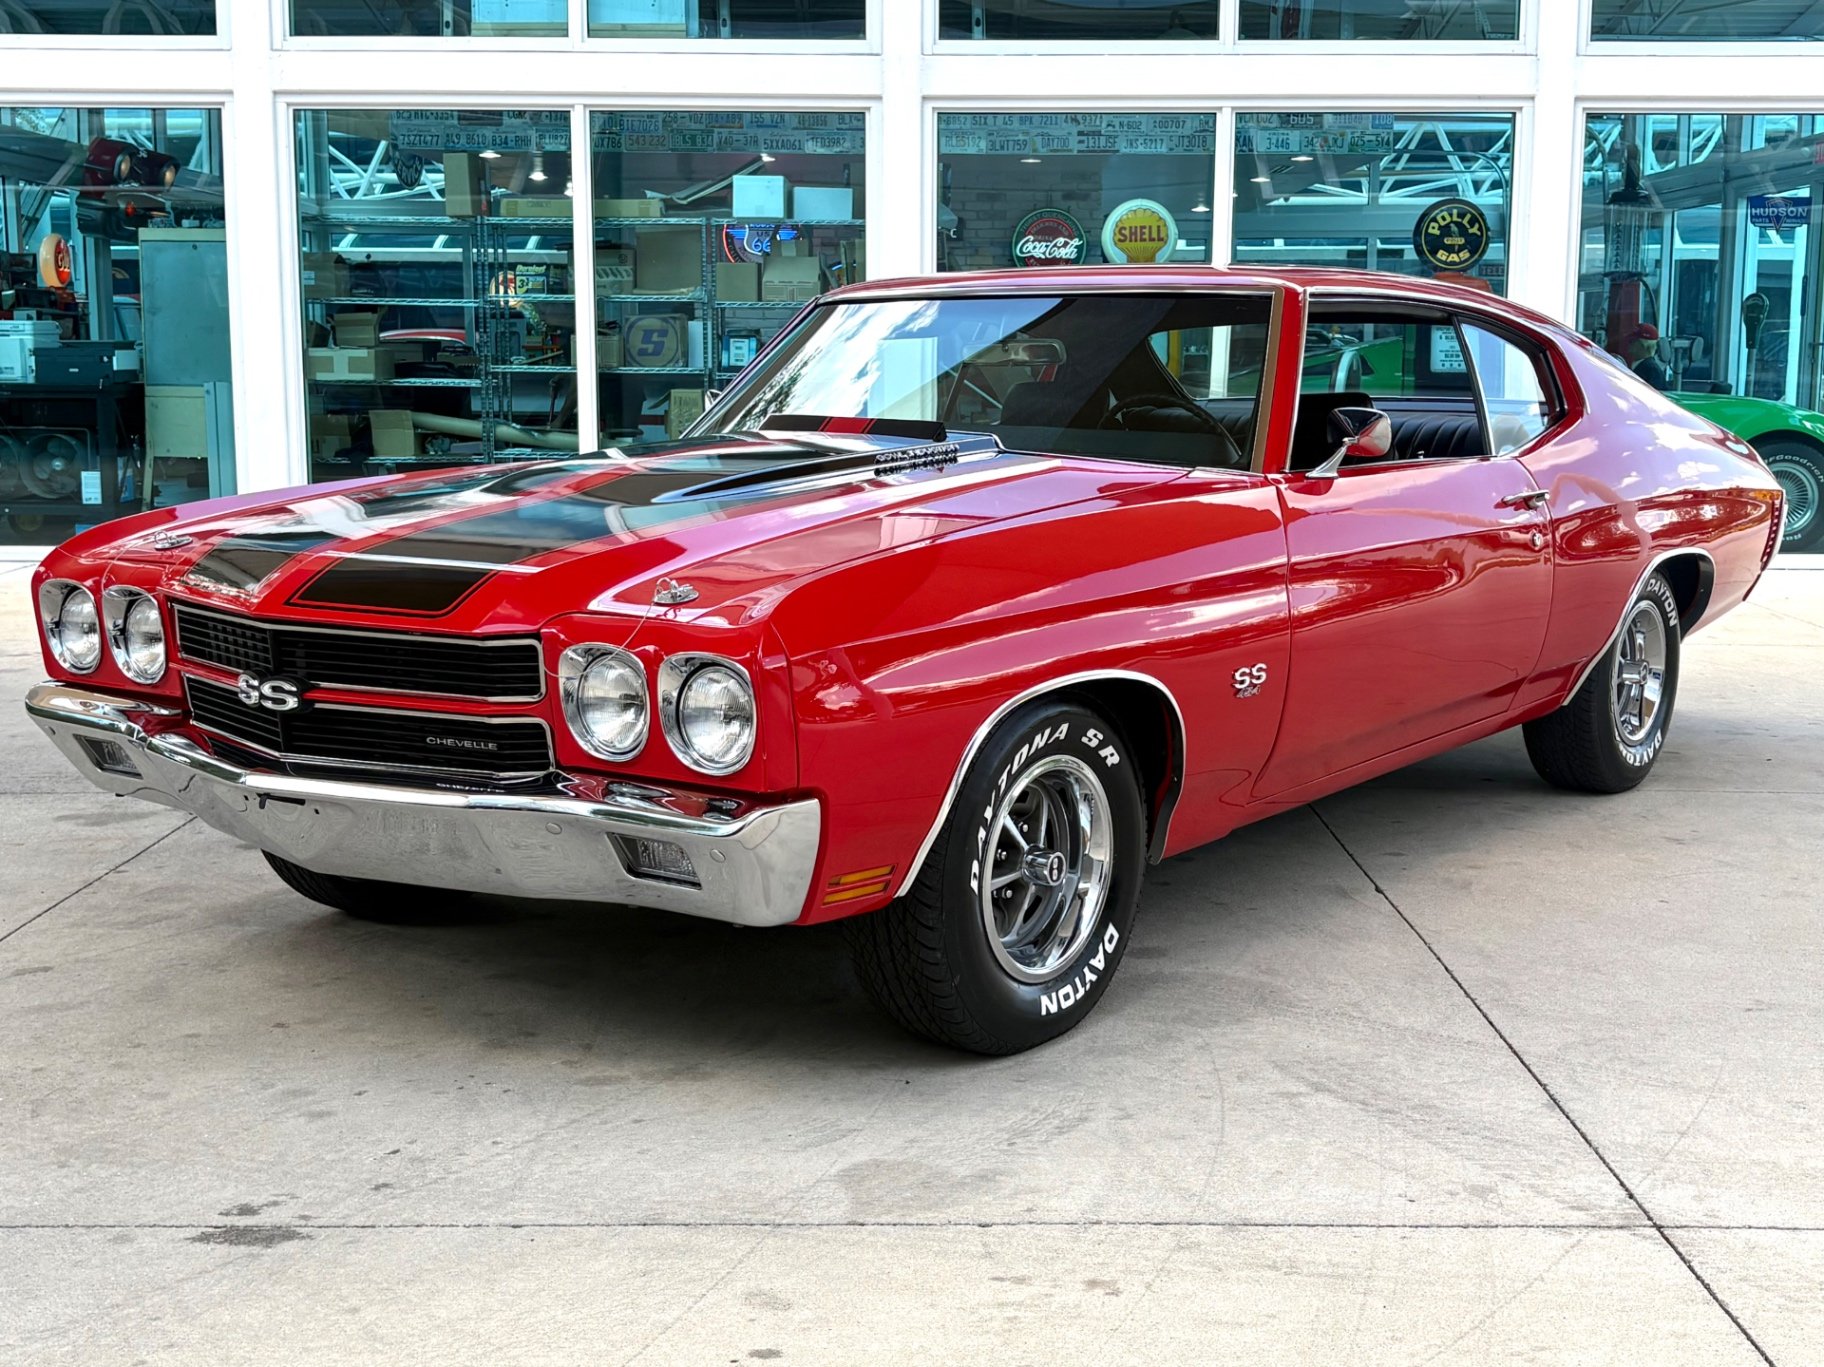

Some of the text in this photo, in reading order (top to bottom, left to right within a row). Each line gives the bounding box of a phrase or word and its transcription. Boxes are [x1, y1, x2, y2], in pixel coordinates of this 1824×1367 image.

[1427, 208, 1482, 236] POLLY
[1751, 207, 1808, 217] HUDSON
[1016, 235, 1083, 259] Coca-Cola
[1117, 225, 1165, 243] SHELL
[1435, 249, 1471, 263] GAS
[1646, 578, 1678, 627] DAYTON
[1232, 662, 1268, 689] SS
[237, 672, 299, 712] SS
[425, 735, 498, 751] CHEVELLE
[970, 722, 1121, 896] DAYTONA SR
[1040, 921, 1120, 1017] DAYTON
